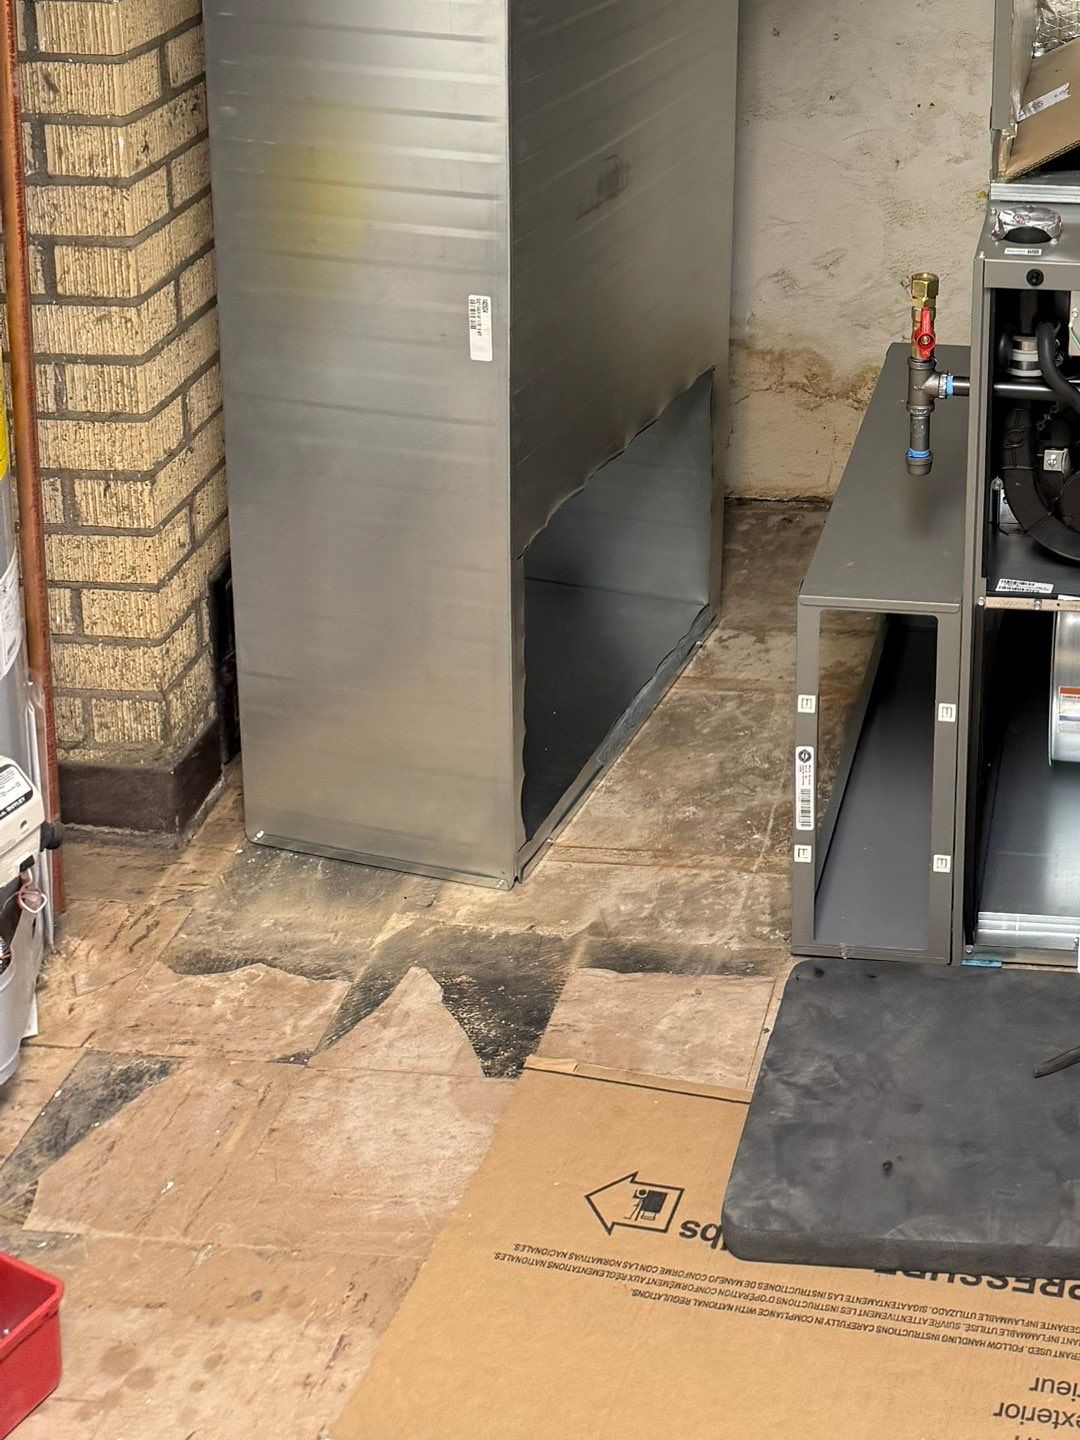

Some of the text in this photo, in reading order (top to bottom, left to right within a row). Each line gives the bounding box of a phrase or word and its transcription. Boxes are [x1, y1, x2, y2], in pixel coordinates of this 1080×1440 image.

[512, 1243, 568, 1259] NACIONALES.
[493, 1252, 547, 1268] NATIONALES.
[568, 1251, 622, 1268] NORMATIVAS
[622, 1260, 639, 1271] LAS
[640, 1263, 658, 1274] CON
[659, 1266, 707, 1282] CONFORME
[627, 1273, 645, 1284] AUX
[708, 1274, 744, 1287] MANEJO
[745, 1279, 756, 1289] DE
[757, 1281, 826, 1299] INSTRUCTIONES
[827, 1291, 844, 1301] LAS
[630, 1289, 691, 1306] REGULATIONS.
[775, 1295, 839, 1313] INSTRUCTIONS
[693, 1298, 734, 1312] NATIONAL
[734, 1304, 757, 1315] WITH
[840, 1305, 857, 1316] LES
[757, 1307, 814, 1323] COMPLIANCE
[858, 1307, 928, 1326] ATTENTIVEMENT
[929, 1305, 976, 1320] UTILIZADO.
[815, 1315, 824, 1325] IN
[825, 1317, 874, 1332] CAREFULLY
[928, 1318, 961, 1330] SUIVRE
[978, 1312, 1039, 1329] INFLAMMABLE
[876, 1324, 940, 1341] INSTRUCTIONS
[998, 1327, 1060, 1344] INFLAMMABLE
[941, 1333, 986, 1347] HANDLING
[987, 1339, 1024, 1353] FOLLOW
[1027, 1345, 1052, 1357] USED.
